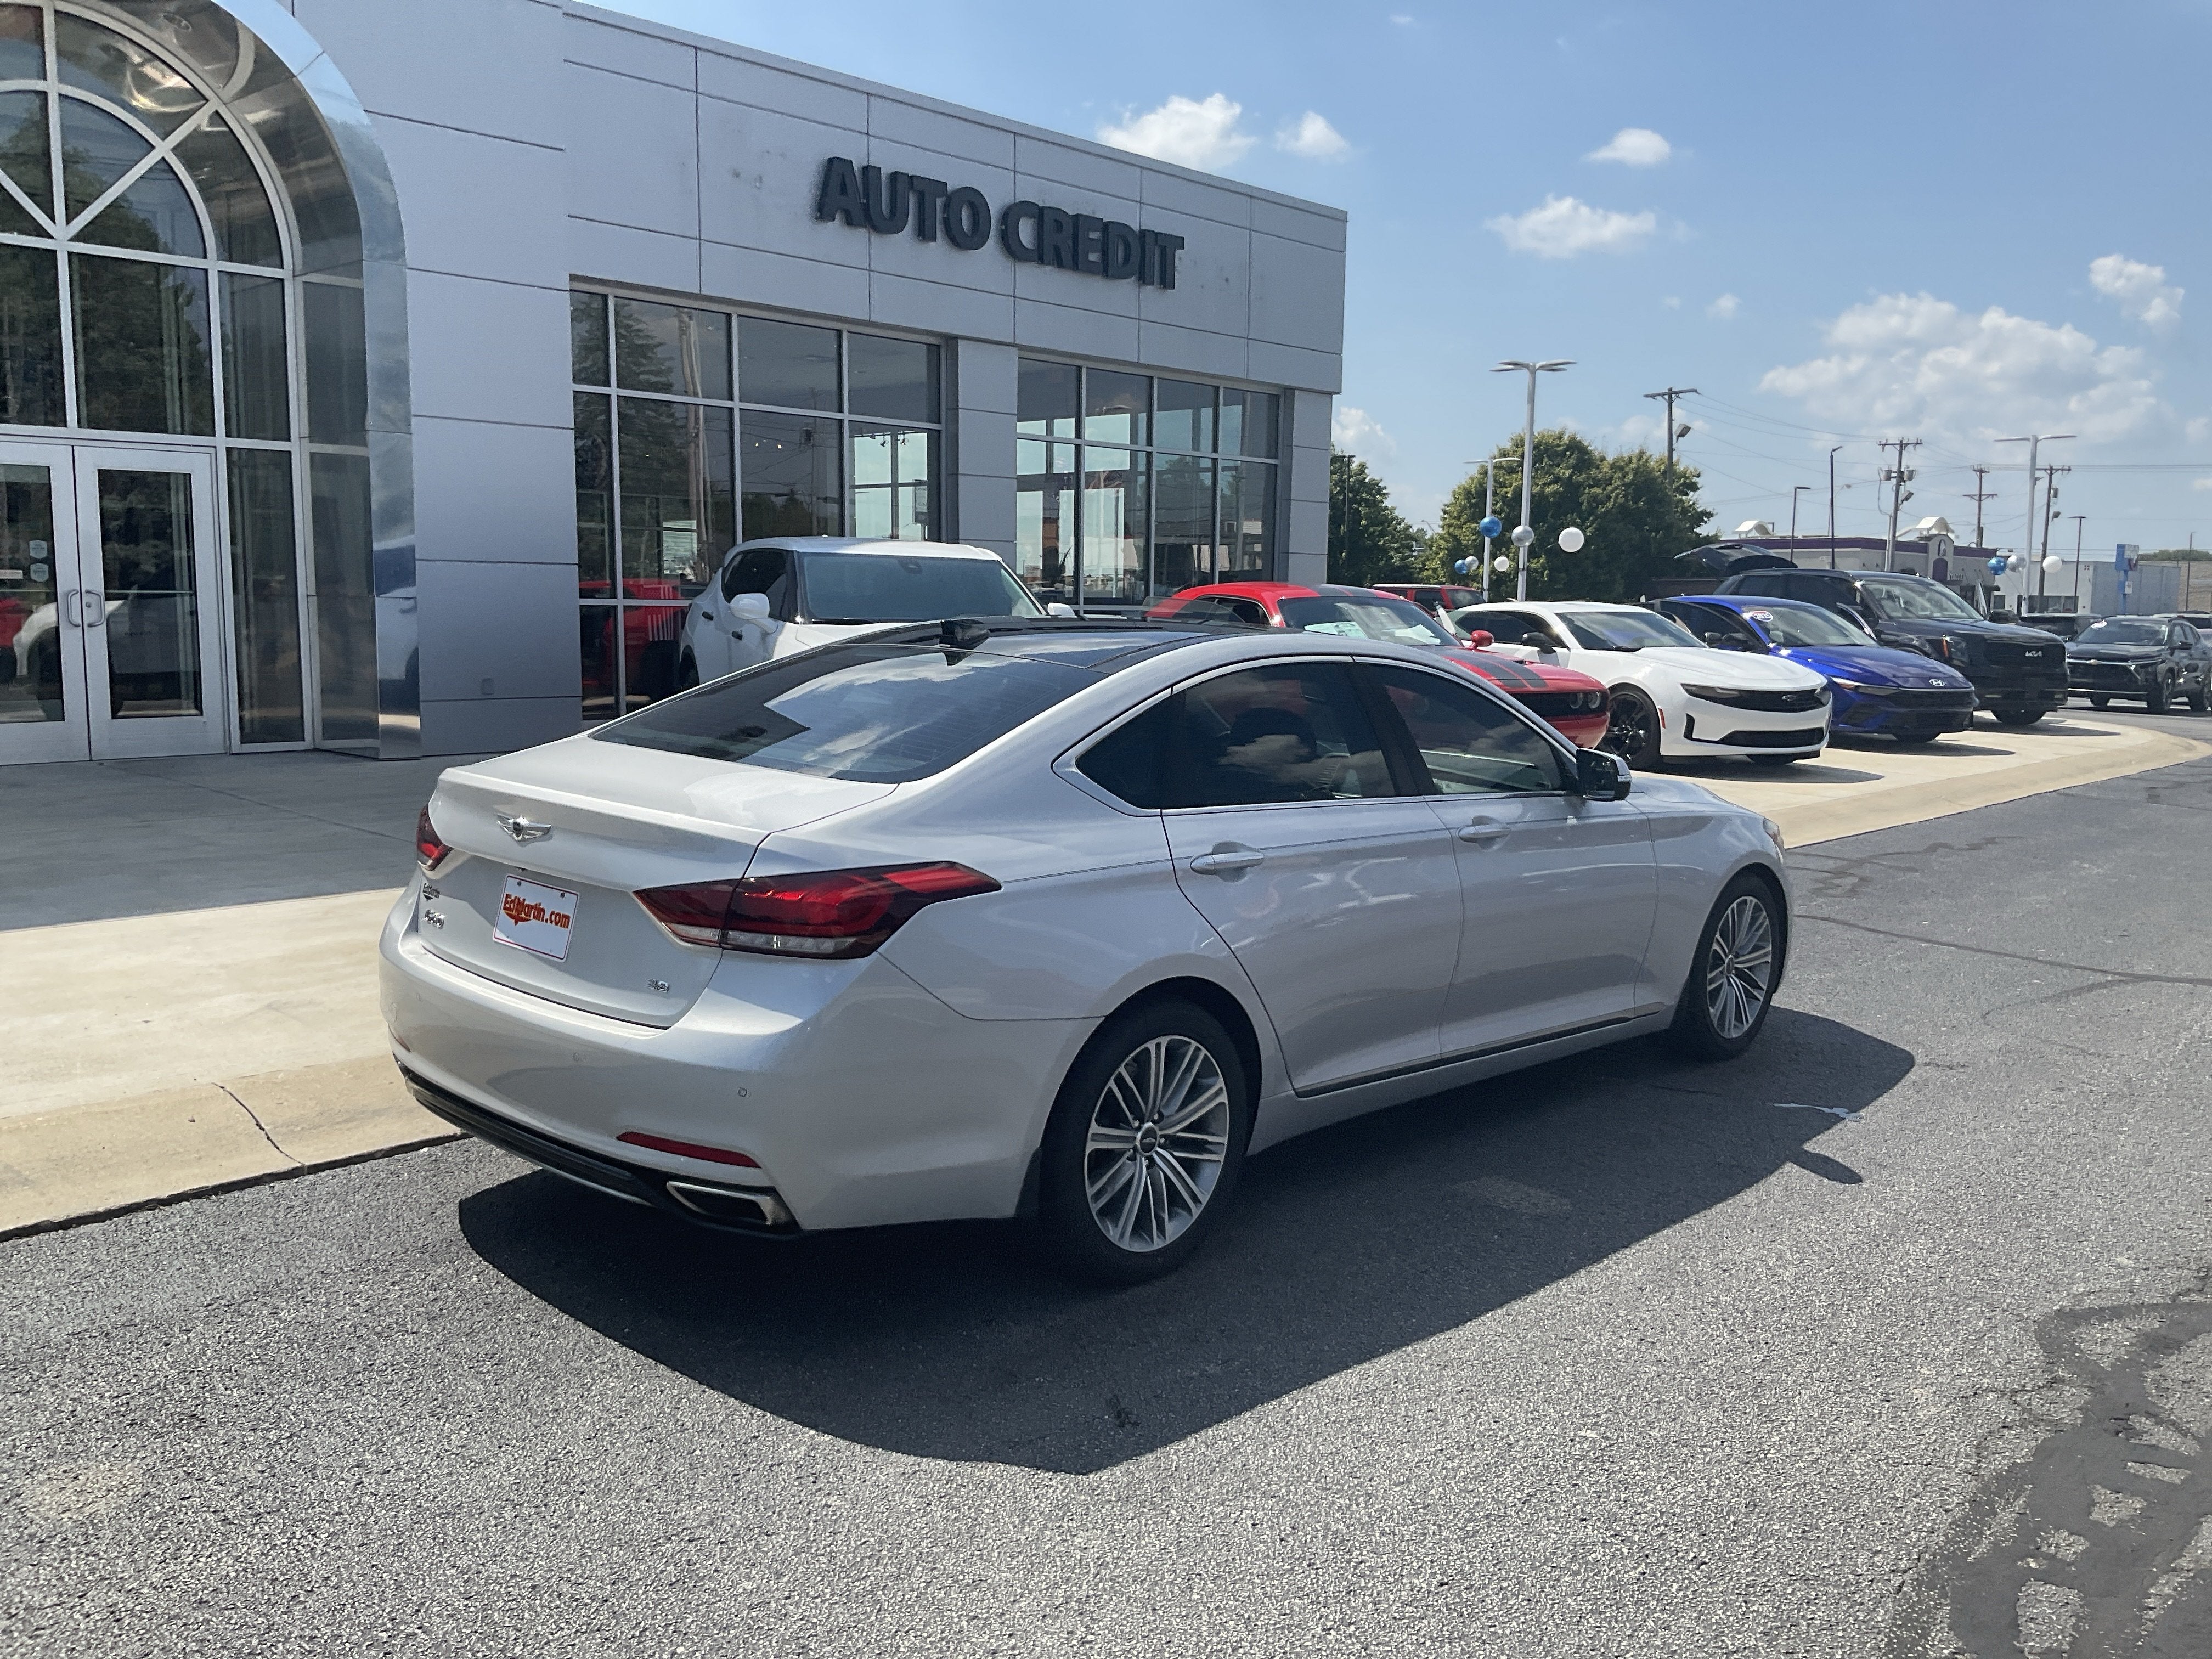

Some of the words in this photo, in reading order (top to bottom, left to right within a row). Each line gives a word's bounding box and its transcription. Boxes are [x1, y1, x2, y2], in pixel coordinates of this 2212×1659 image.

[815, 156, 991, 250] AUTO
[1001, 200, 1184, 290] CREDIT
[503, 893, 571, 929] EdMartin.com
